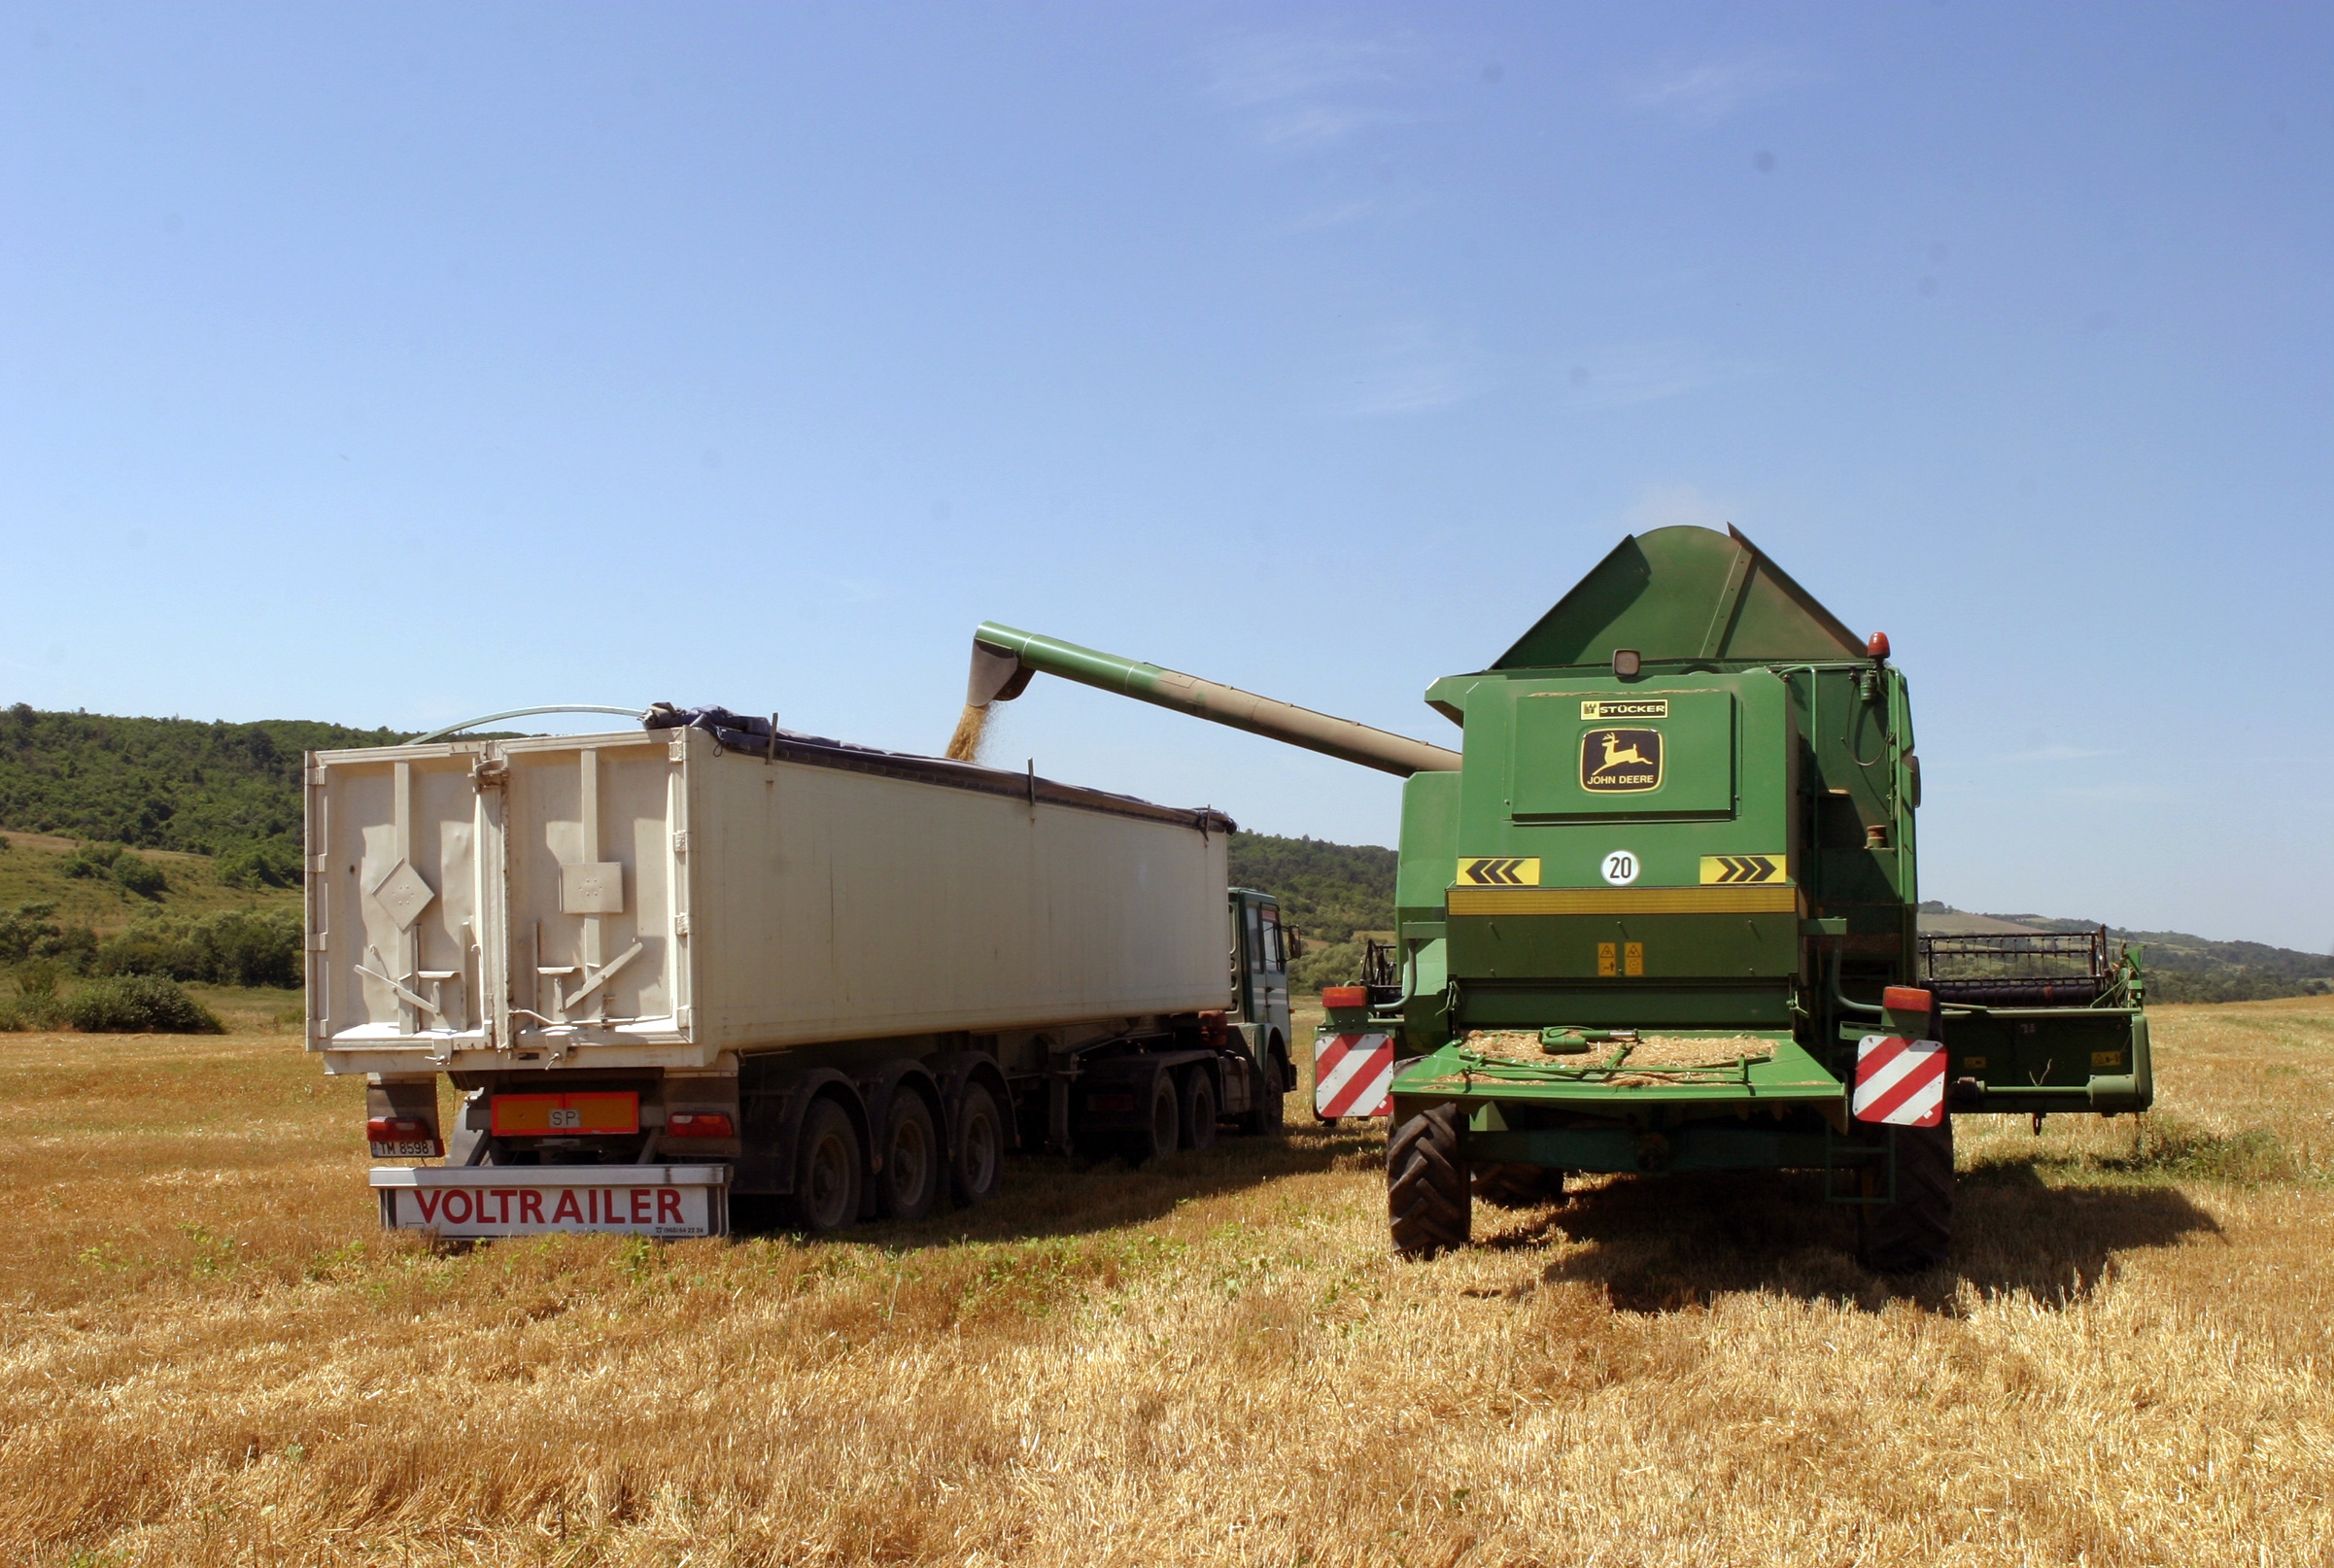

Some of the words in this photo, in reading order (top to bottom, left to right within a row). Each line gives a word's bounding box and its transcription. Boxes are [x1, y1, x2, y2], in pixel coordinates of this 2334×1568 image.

[1599, 704, 1665, 714] STÜCKER
[1587, 775, 1616, 785] JOHN
[1619, 774, 1654, 784] DEERE
[1609, 856, 1632, 879] 20
[552, 1110, 576, 1126] SP
[379, 1142, 396, 1155] TM
[398, 1141, 429, 1155] 8598
[413, 1188, 684, 1224] VOLTRAILER
